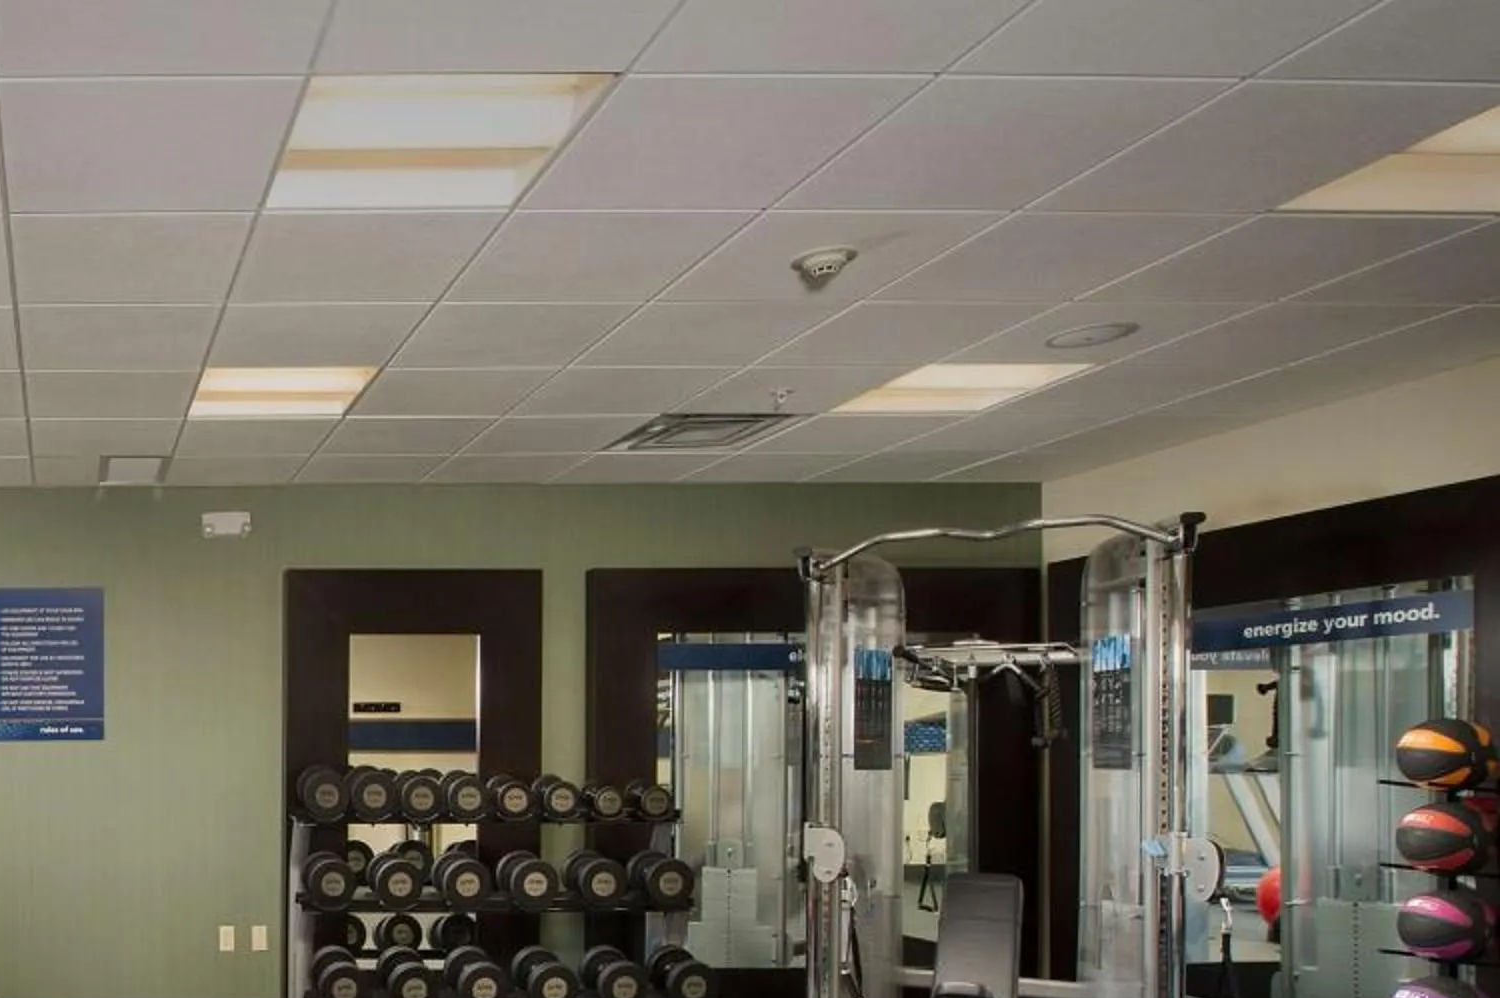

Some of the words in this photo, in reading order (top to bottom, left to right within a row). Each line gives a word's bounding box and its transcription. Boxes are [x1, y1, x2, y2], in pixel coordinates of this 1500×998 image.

[1243, 617, 1319, 639] energize
[1323, 612, 1369, 635] your
[1373, 601, 1441, 625] mood.
